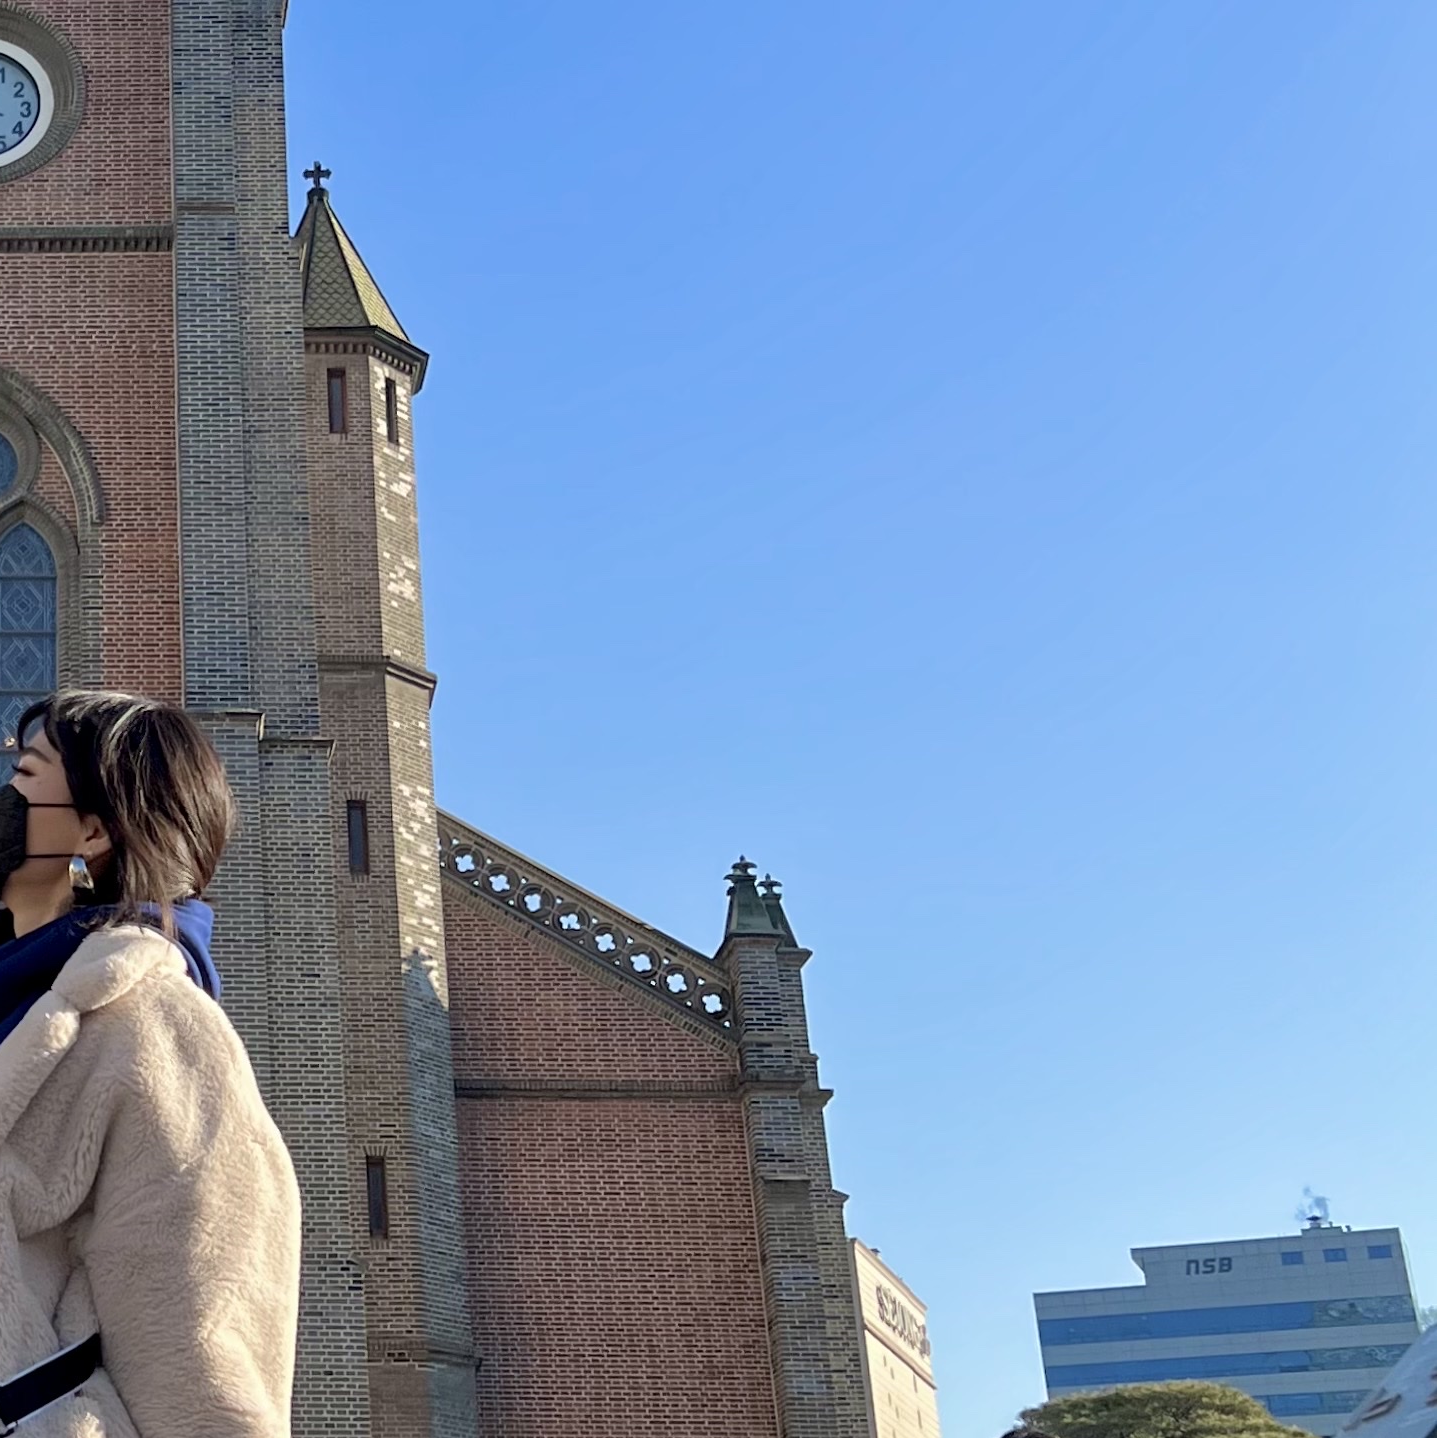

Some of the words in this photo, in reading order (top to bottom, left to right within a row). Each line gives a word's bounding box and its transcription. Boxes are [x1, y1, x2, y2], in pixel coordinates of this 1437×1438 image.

[13, 81, 25, 98] 2
[19, 101, 32, 118] 3
[12, 121, 24, 137] 4
